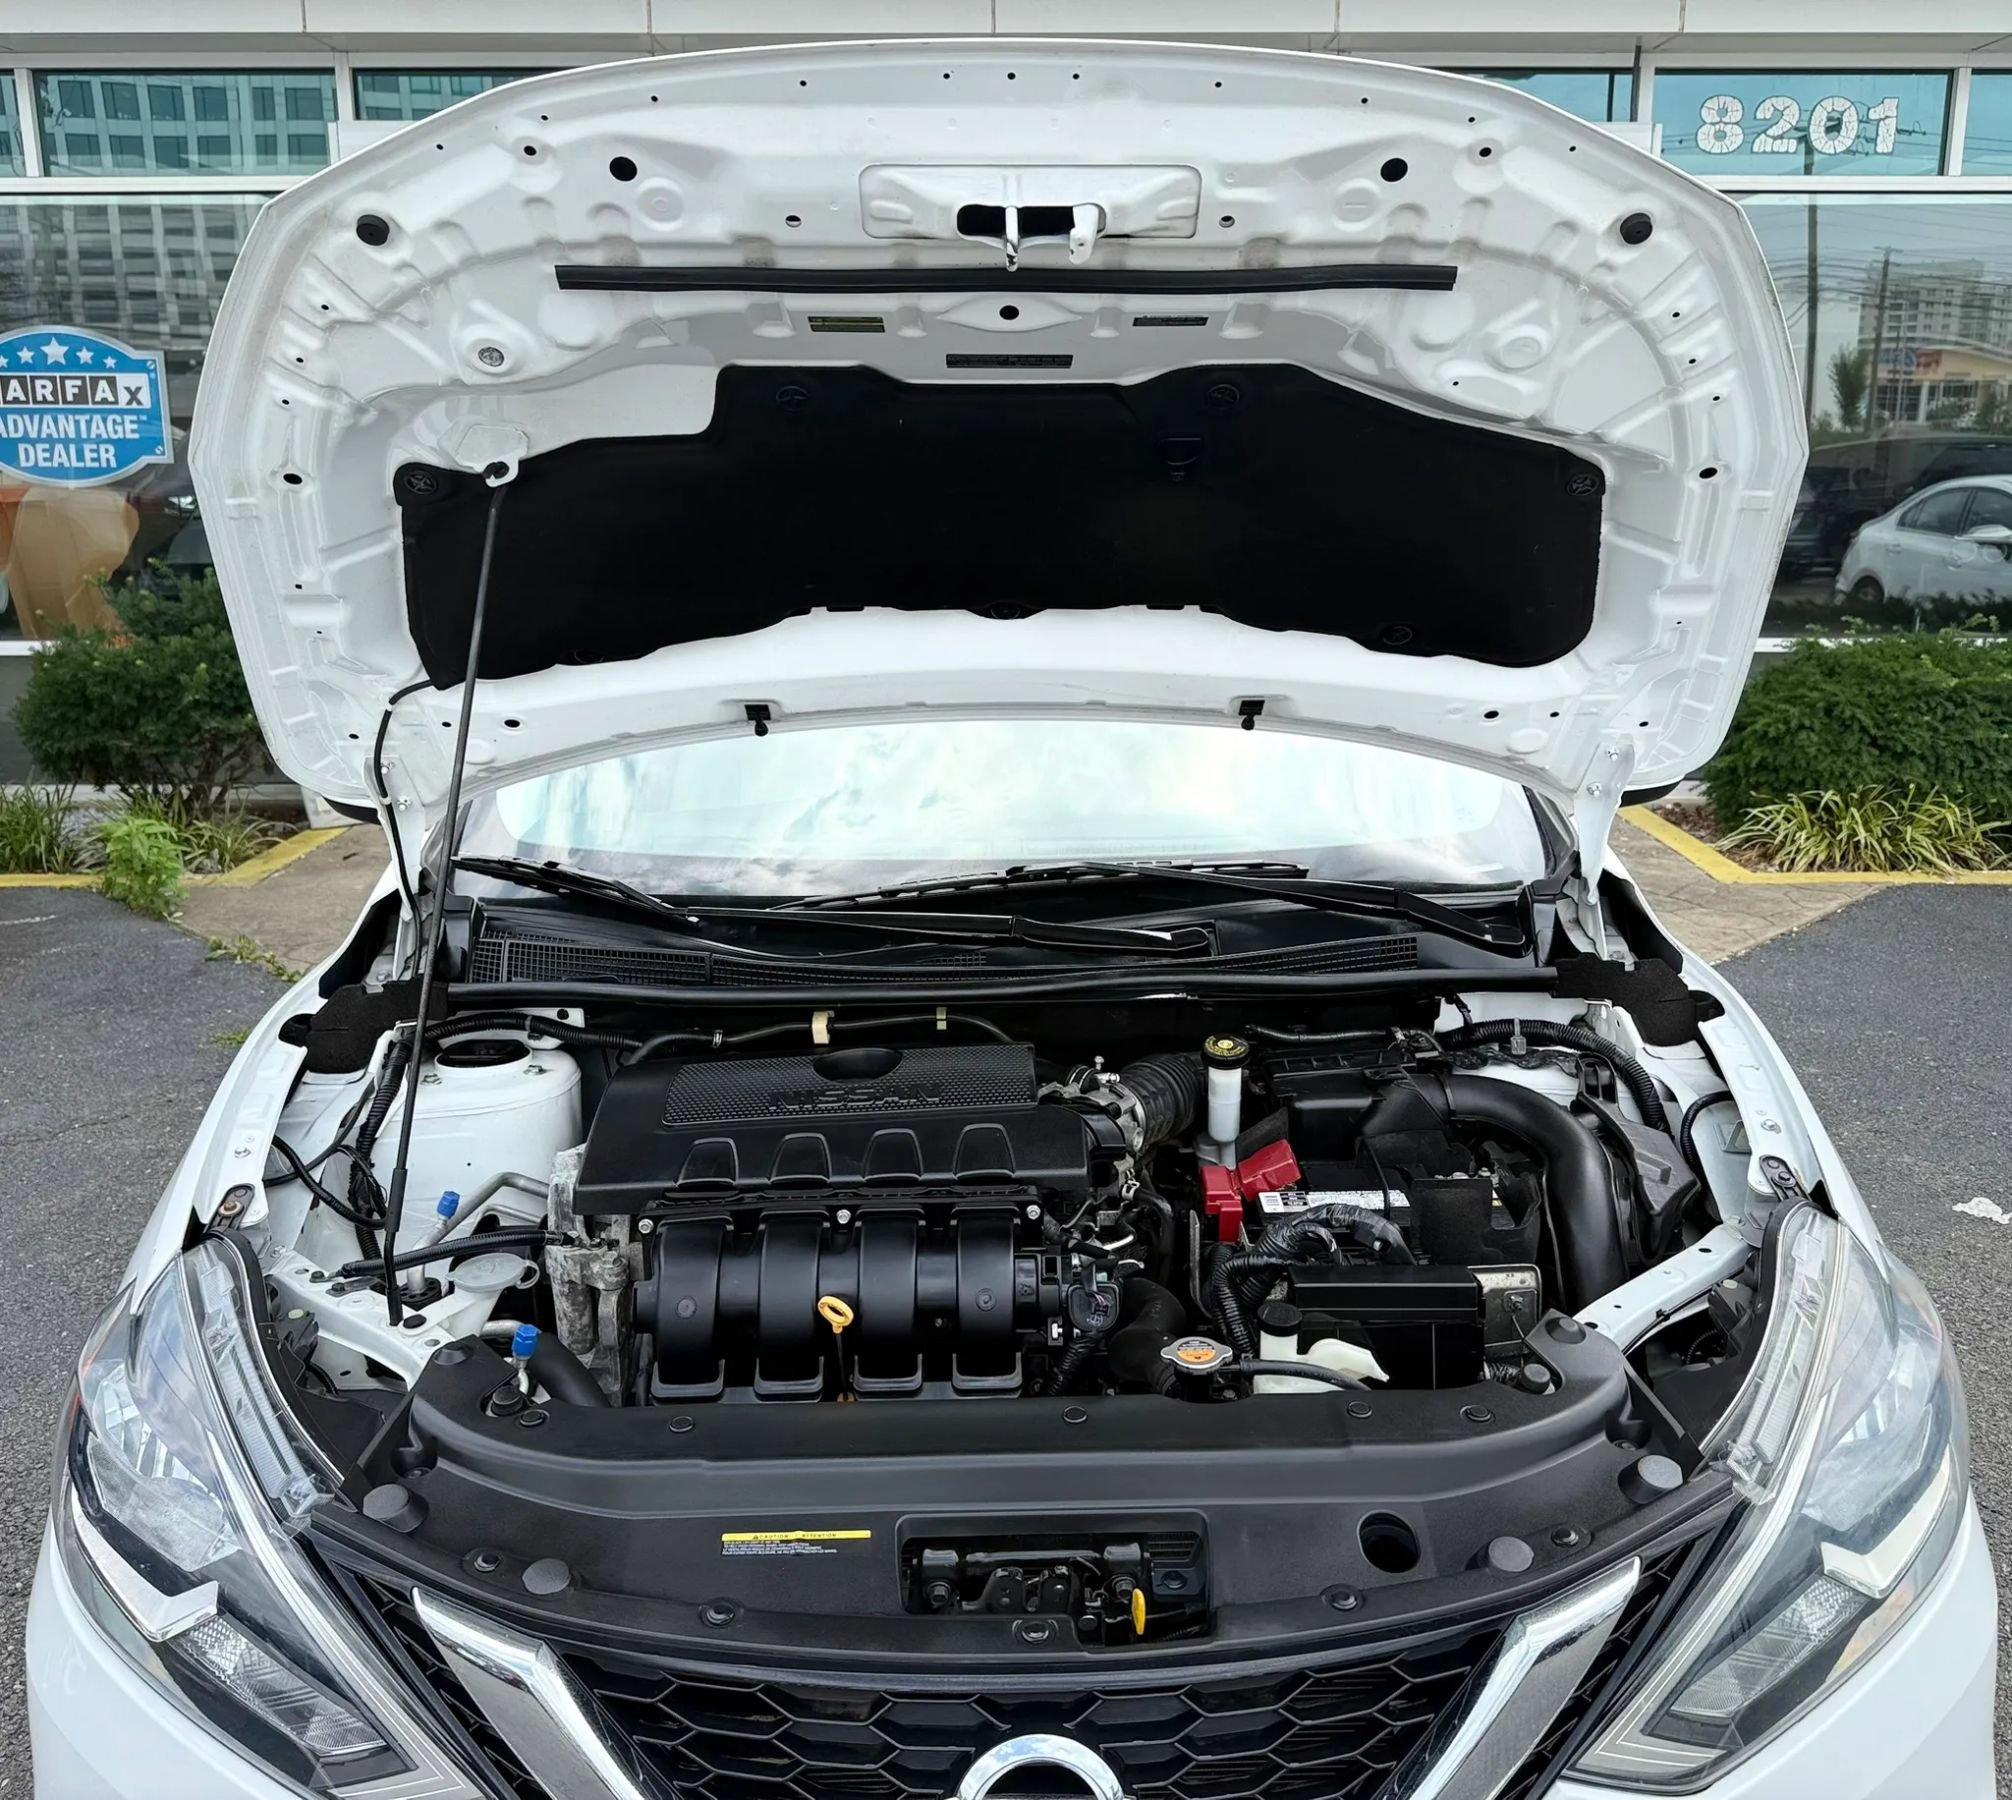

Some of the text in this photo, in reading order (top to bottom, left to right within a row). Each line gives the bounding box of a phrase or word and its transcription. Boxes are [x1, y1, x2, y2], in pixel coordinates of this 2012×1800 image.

[1696, 94, 1900, 155] 8201
[4, 378, 144, 406] ARFAX
[17, 443, 117, 468] DEALER
[768, 1085, 940, 1110] NISSAN
